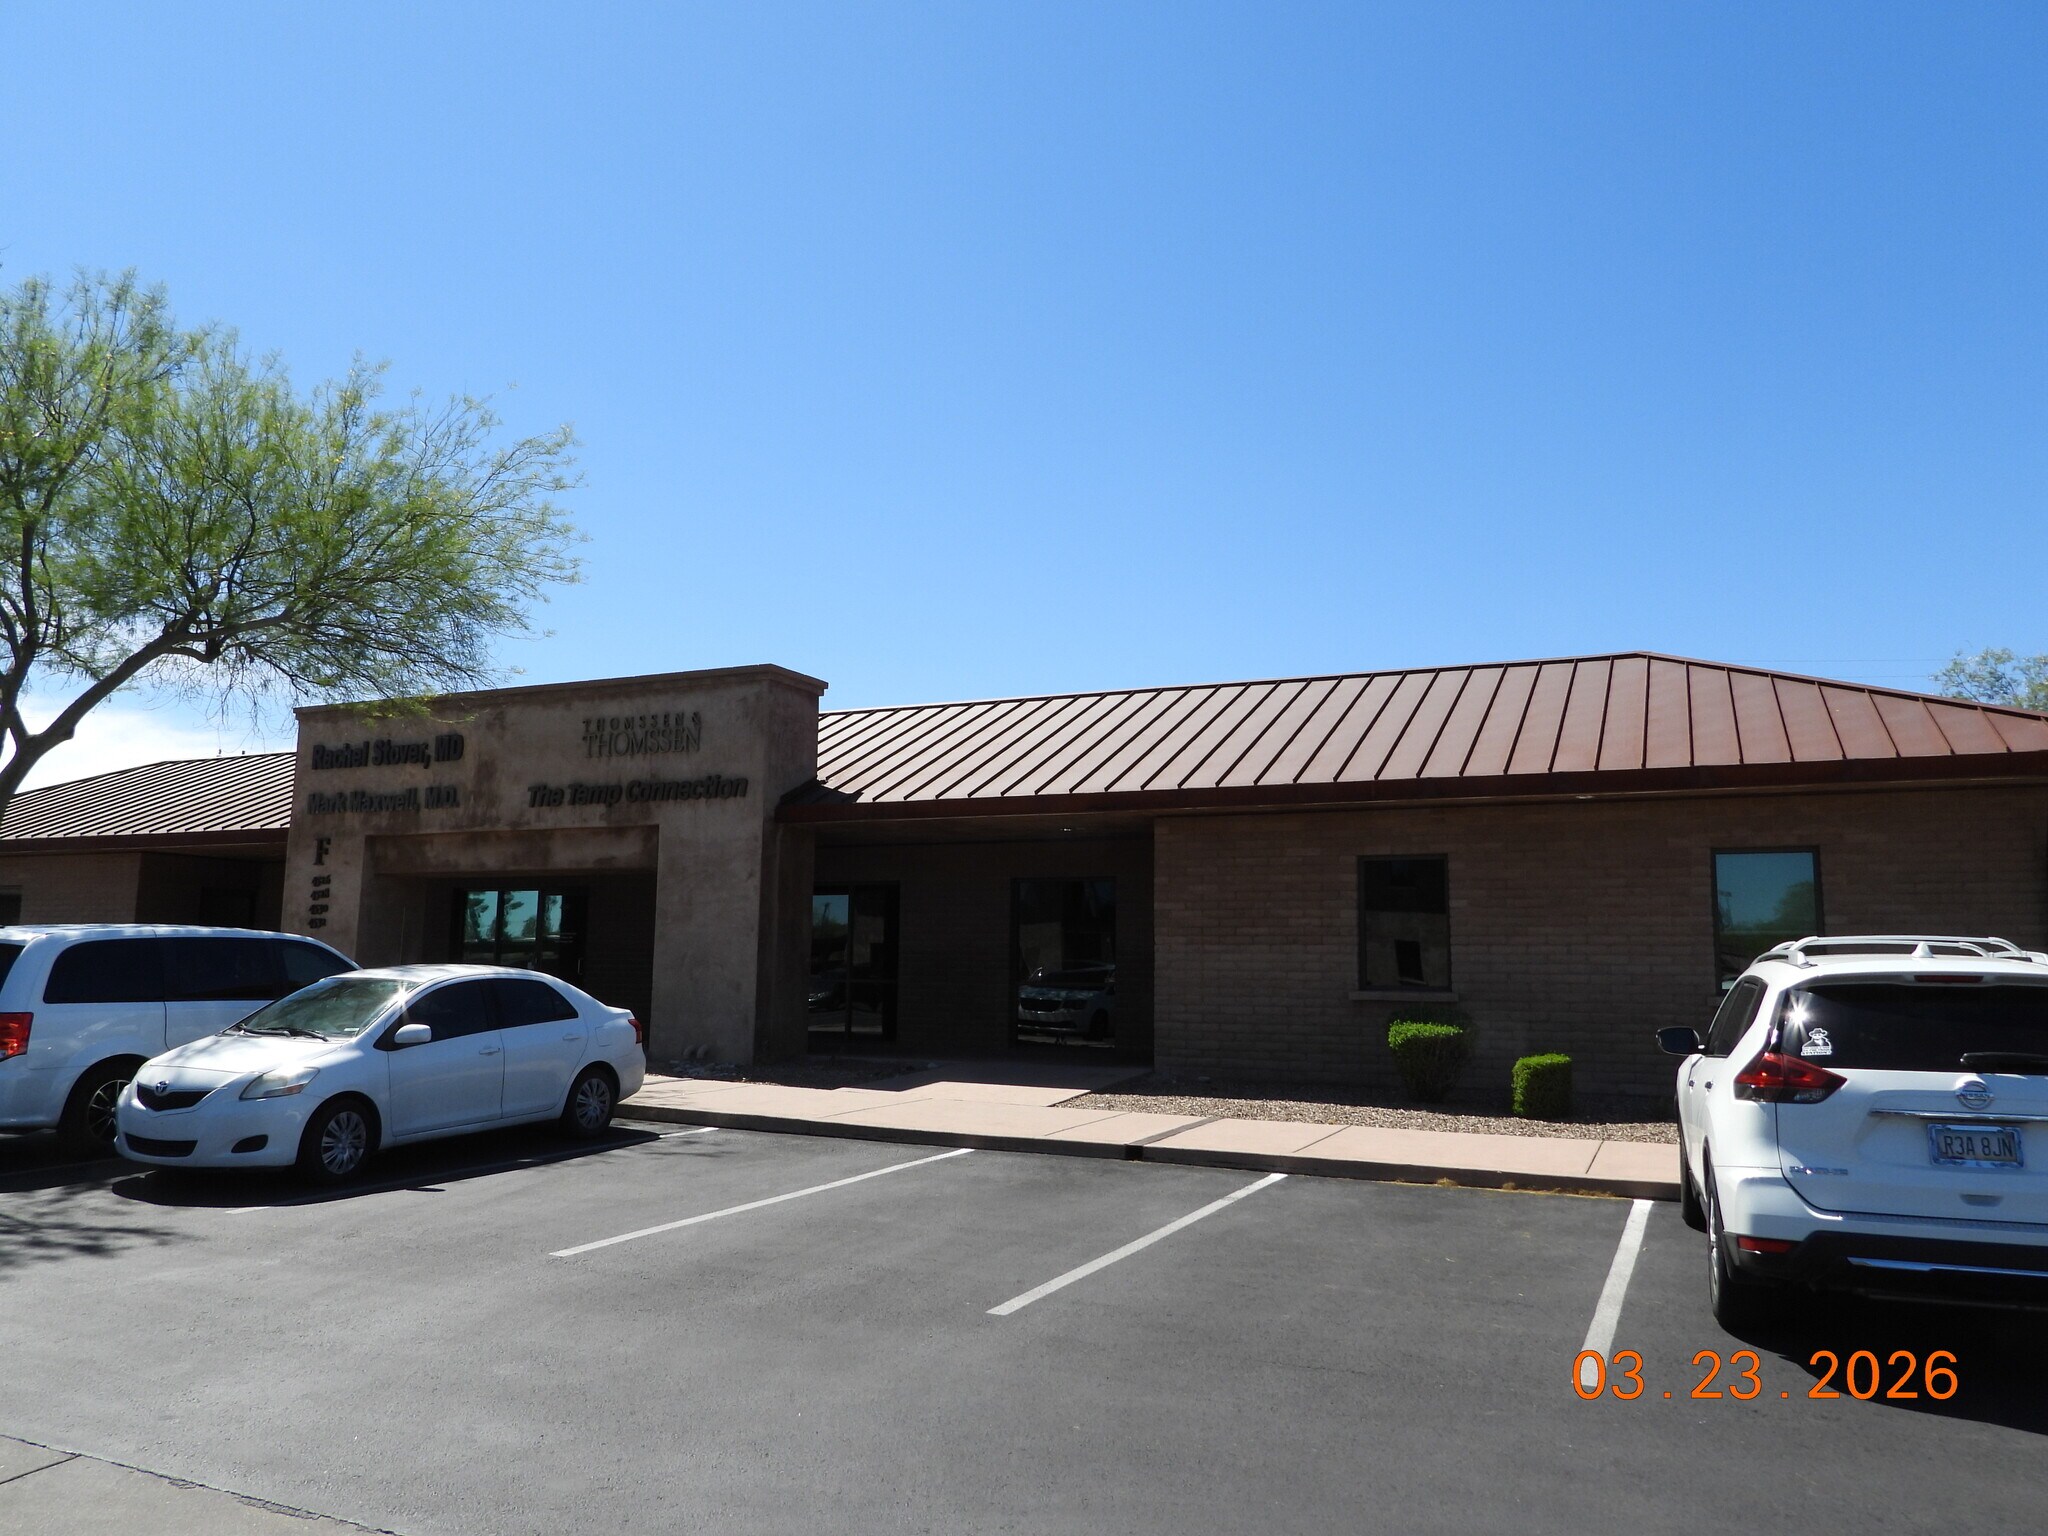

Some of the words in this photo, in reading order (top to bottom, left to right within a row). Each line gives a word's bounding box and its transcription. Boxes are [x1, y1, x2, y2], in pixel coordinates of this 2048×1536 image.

[582, 712, 685, 733] THOMSSEN
[312, 741, 370, 770] Rachel
[372, 739, 431, 769] Stover,
[434, 734, 465, 762] MD
[582, 727, 701, 759] THOMSSEN
[308, 792, 347, 814] Mark
[350, 788, 421, 814] Maxwell,
[528, 785, 565, 808] The
[568, 782, 623, 807] Temp
[626, 774, 749, 803] Connection
[312, 837, 332, 866] F
[1942, 1135, 1976, 1156] R3A
[1981, 1136, 2014, 1158] 8JN
